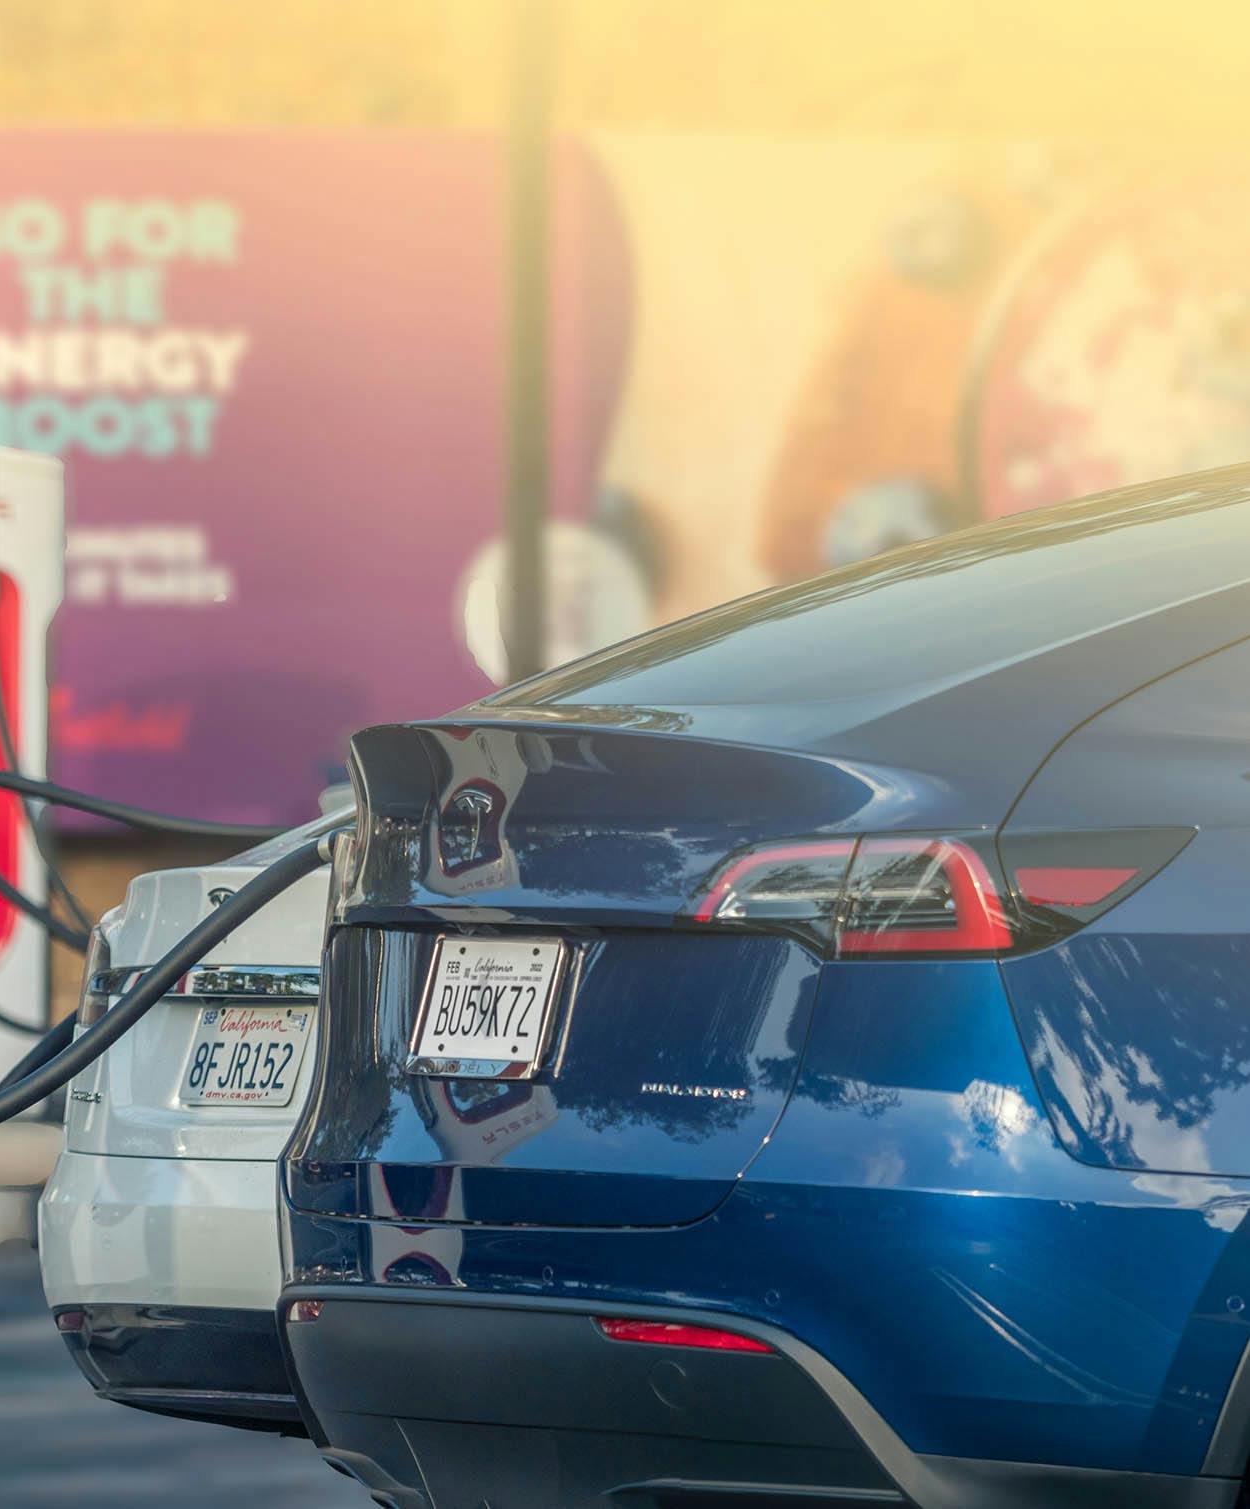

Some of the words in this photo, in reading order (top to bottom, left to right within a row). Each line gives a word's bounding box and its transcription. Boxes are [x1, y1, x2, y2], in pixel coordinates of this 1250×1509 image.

[84, 200, 241, 263] FOR
[19, 266, 165, 325] THE
[446, 961, 461, 974] FEB
[203, 1010, 219, 1025] SEP
[219, 1009, 288, 1039] California
[433, 984, 536, 1037] BU59K72
[189, 1042, 294, 1089] 8FJR152
[205, 1090, 263, 1100] dmv.ca.gov
